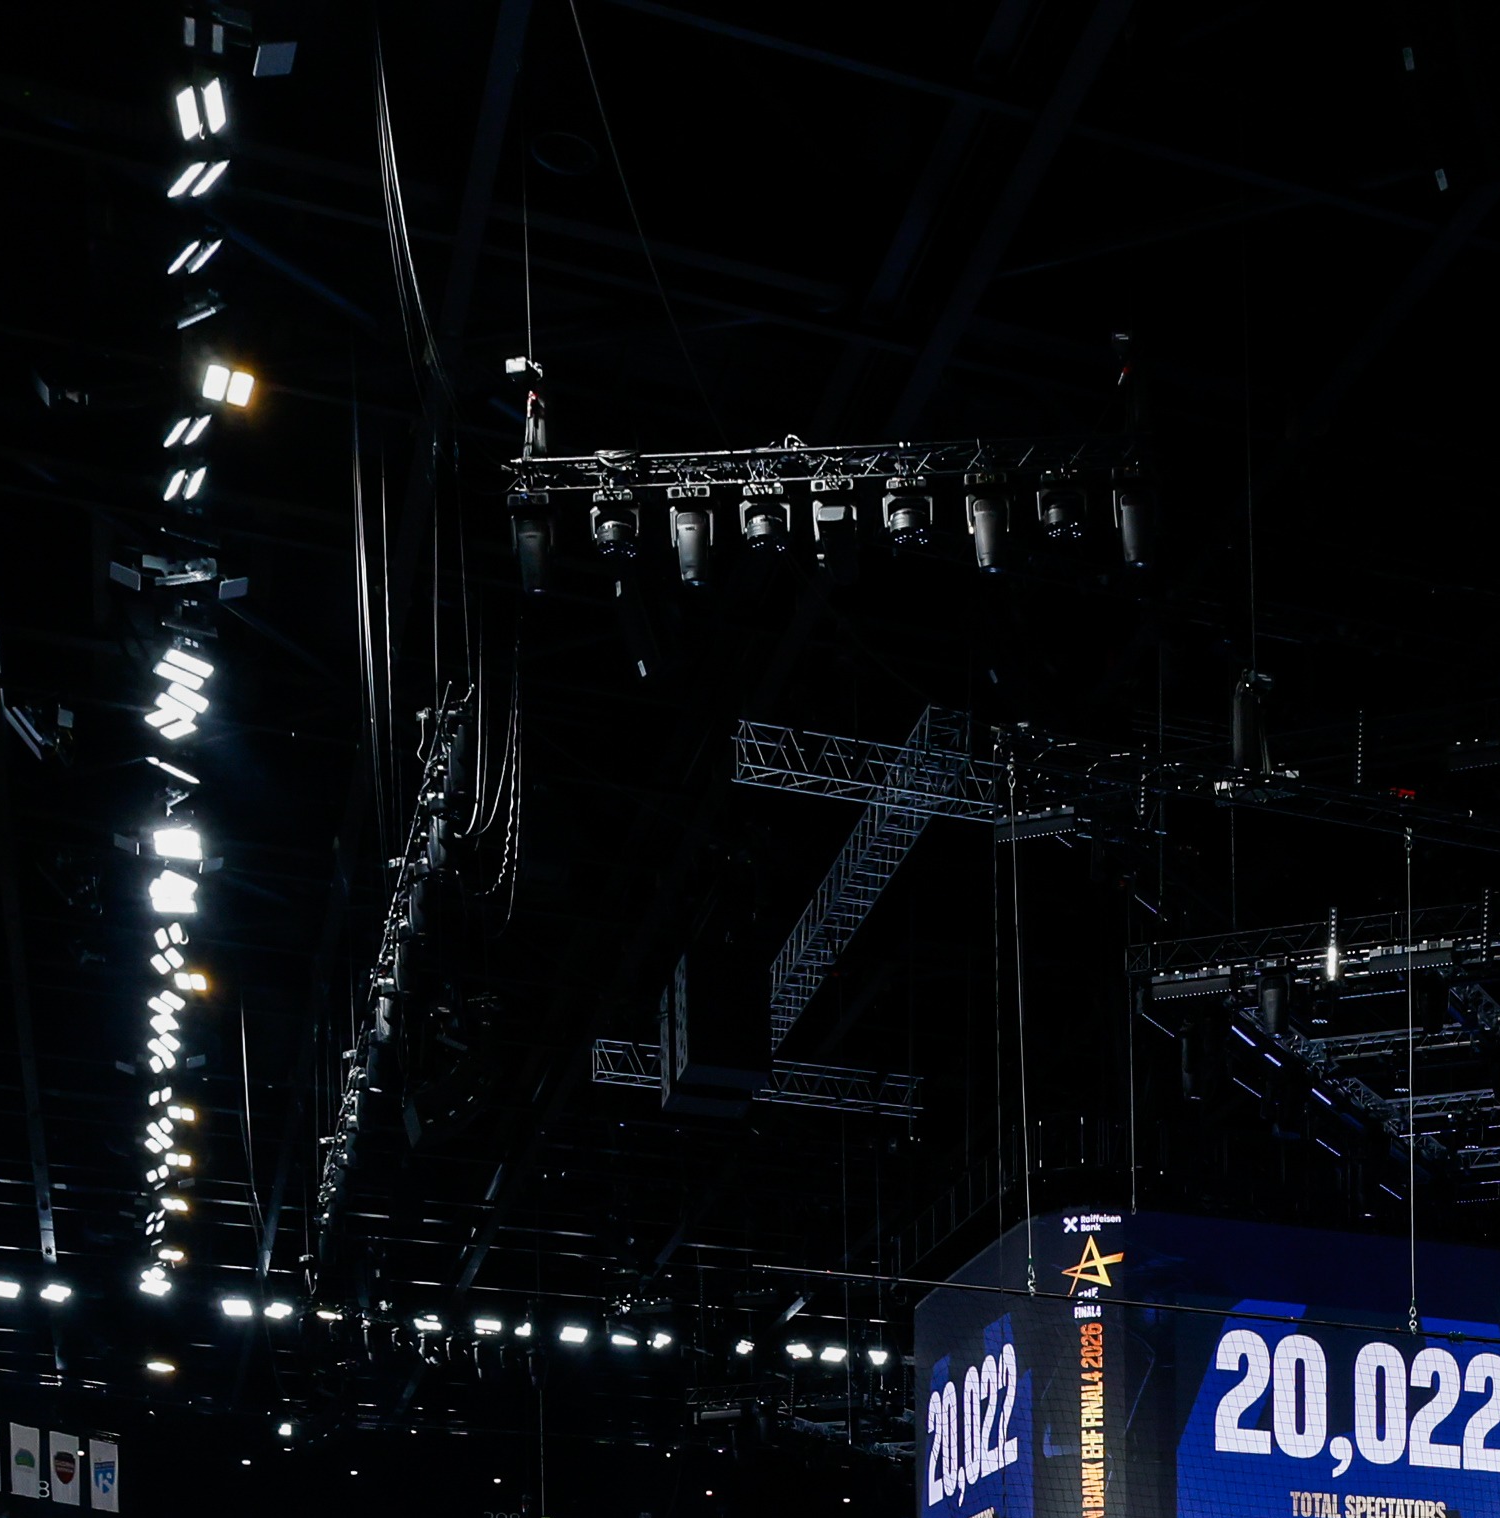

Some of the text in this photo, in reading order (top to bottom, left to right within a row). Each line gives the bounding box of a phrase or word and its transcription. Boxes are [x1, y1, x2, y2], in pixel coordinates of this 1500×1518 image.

[1080, 1213, 1121, 1224] Raiffeisen
[1080, 1223, 1101, 1232] Bank
[1081, 1322, 1103, 1369] 2026
[928, 1343, 1018, 1507] 20,022
[1081, 1429, 1104, 1460] EHF
[1081, 1461, 1104, 1508] BANK
